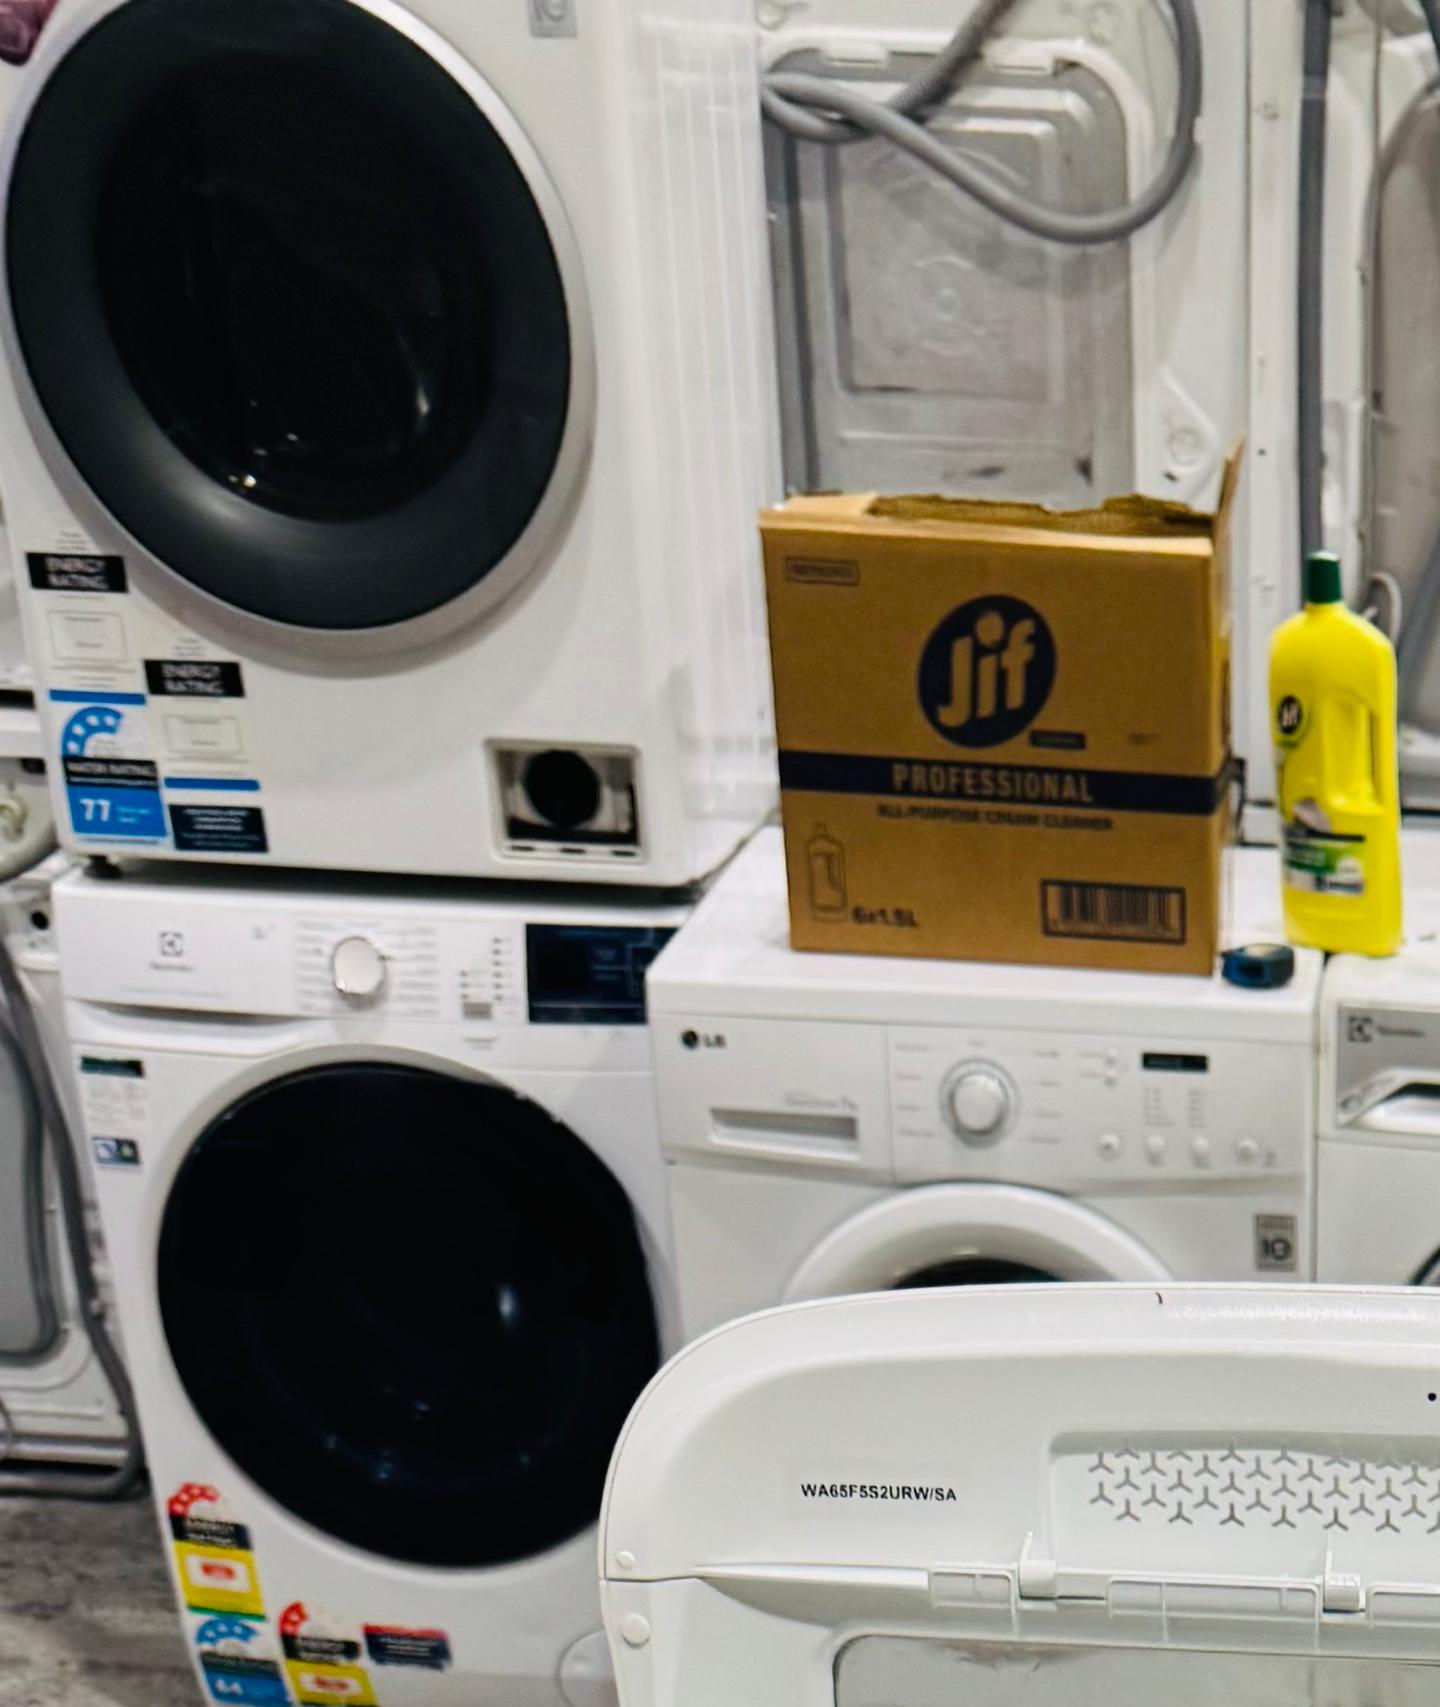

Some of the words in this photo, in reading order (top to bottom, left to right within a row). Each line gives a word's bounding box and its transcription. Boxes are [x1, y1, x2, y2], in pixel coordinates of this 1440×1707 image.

[892, 763, 1094, 802] PROFESSIONAL
[80, 798, 112, 823] 77
[800, 1483, 957, 1502] WA65F5S2URW/SA
